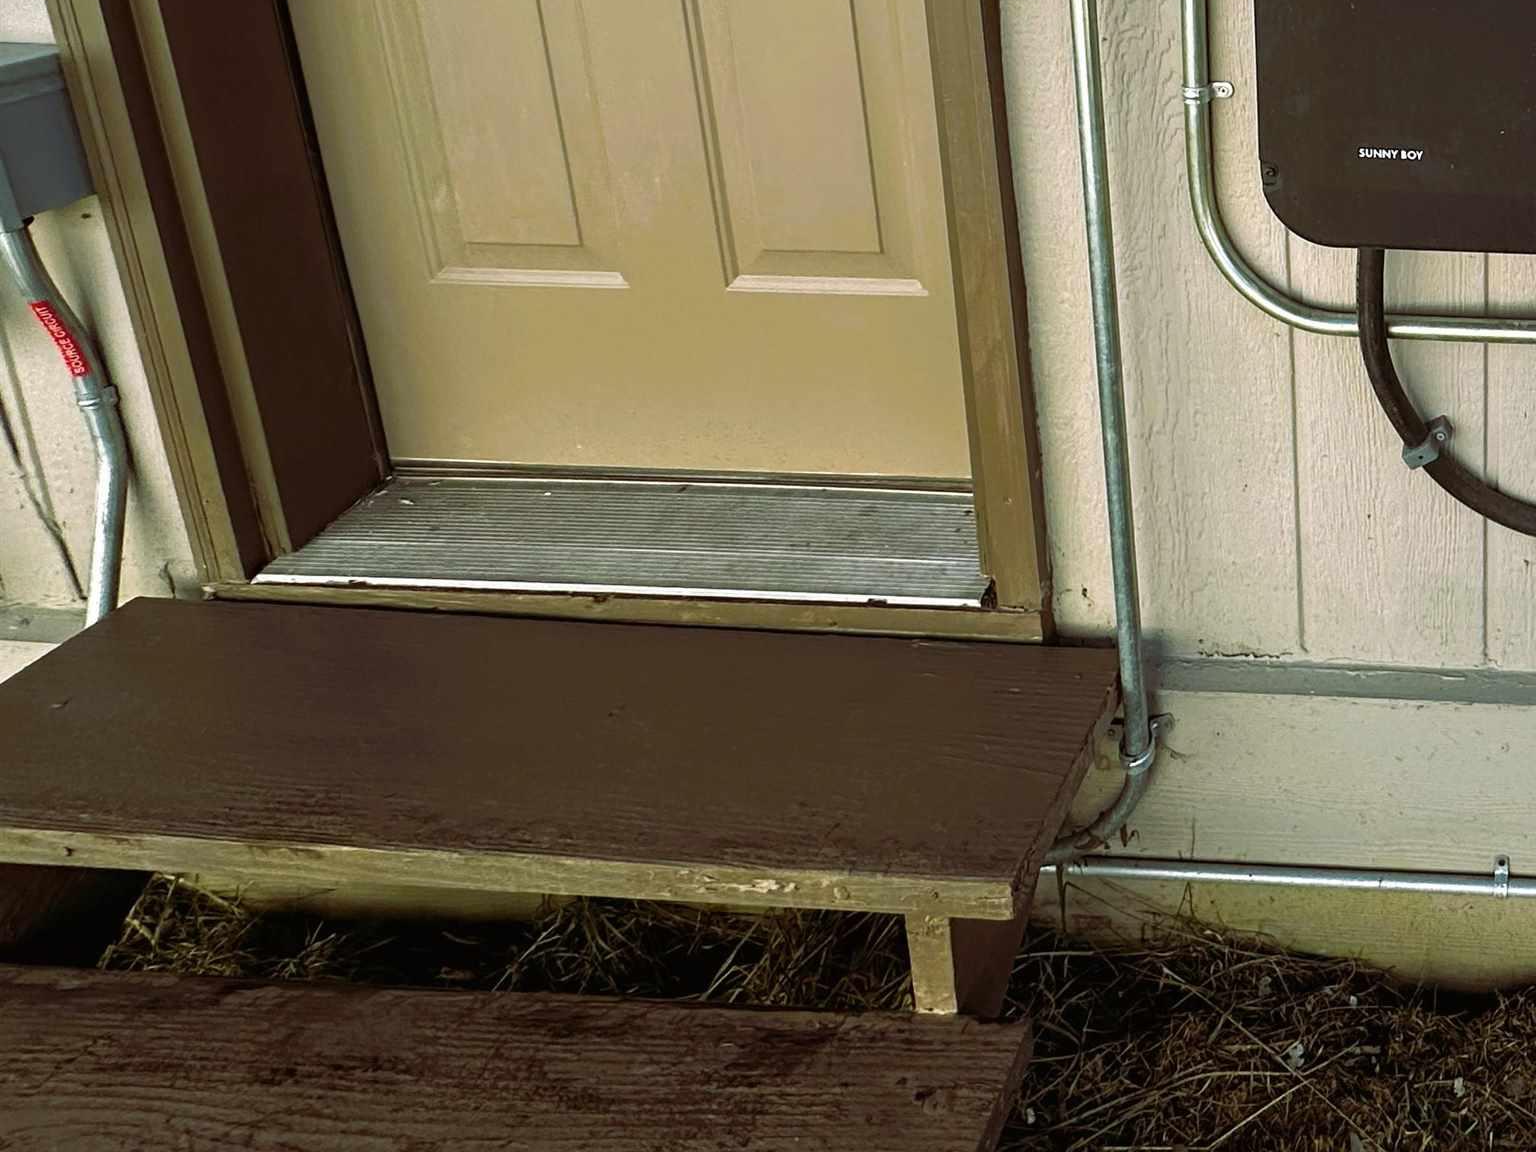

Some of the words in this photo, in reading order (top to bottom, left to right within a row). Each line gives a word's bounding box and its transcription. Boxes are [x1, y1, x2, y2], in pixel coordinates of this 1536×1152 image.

[1358, 147, 1399, 159] SUNNY
[1400, 149, 1424, 161] BOY
[34, 306, 66, 338] CIRCUIT
[59, 337, 85, 374] SOURCE
